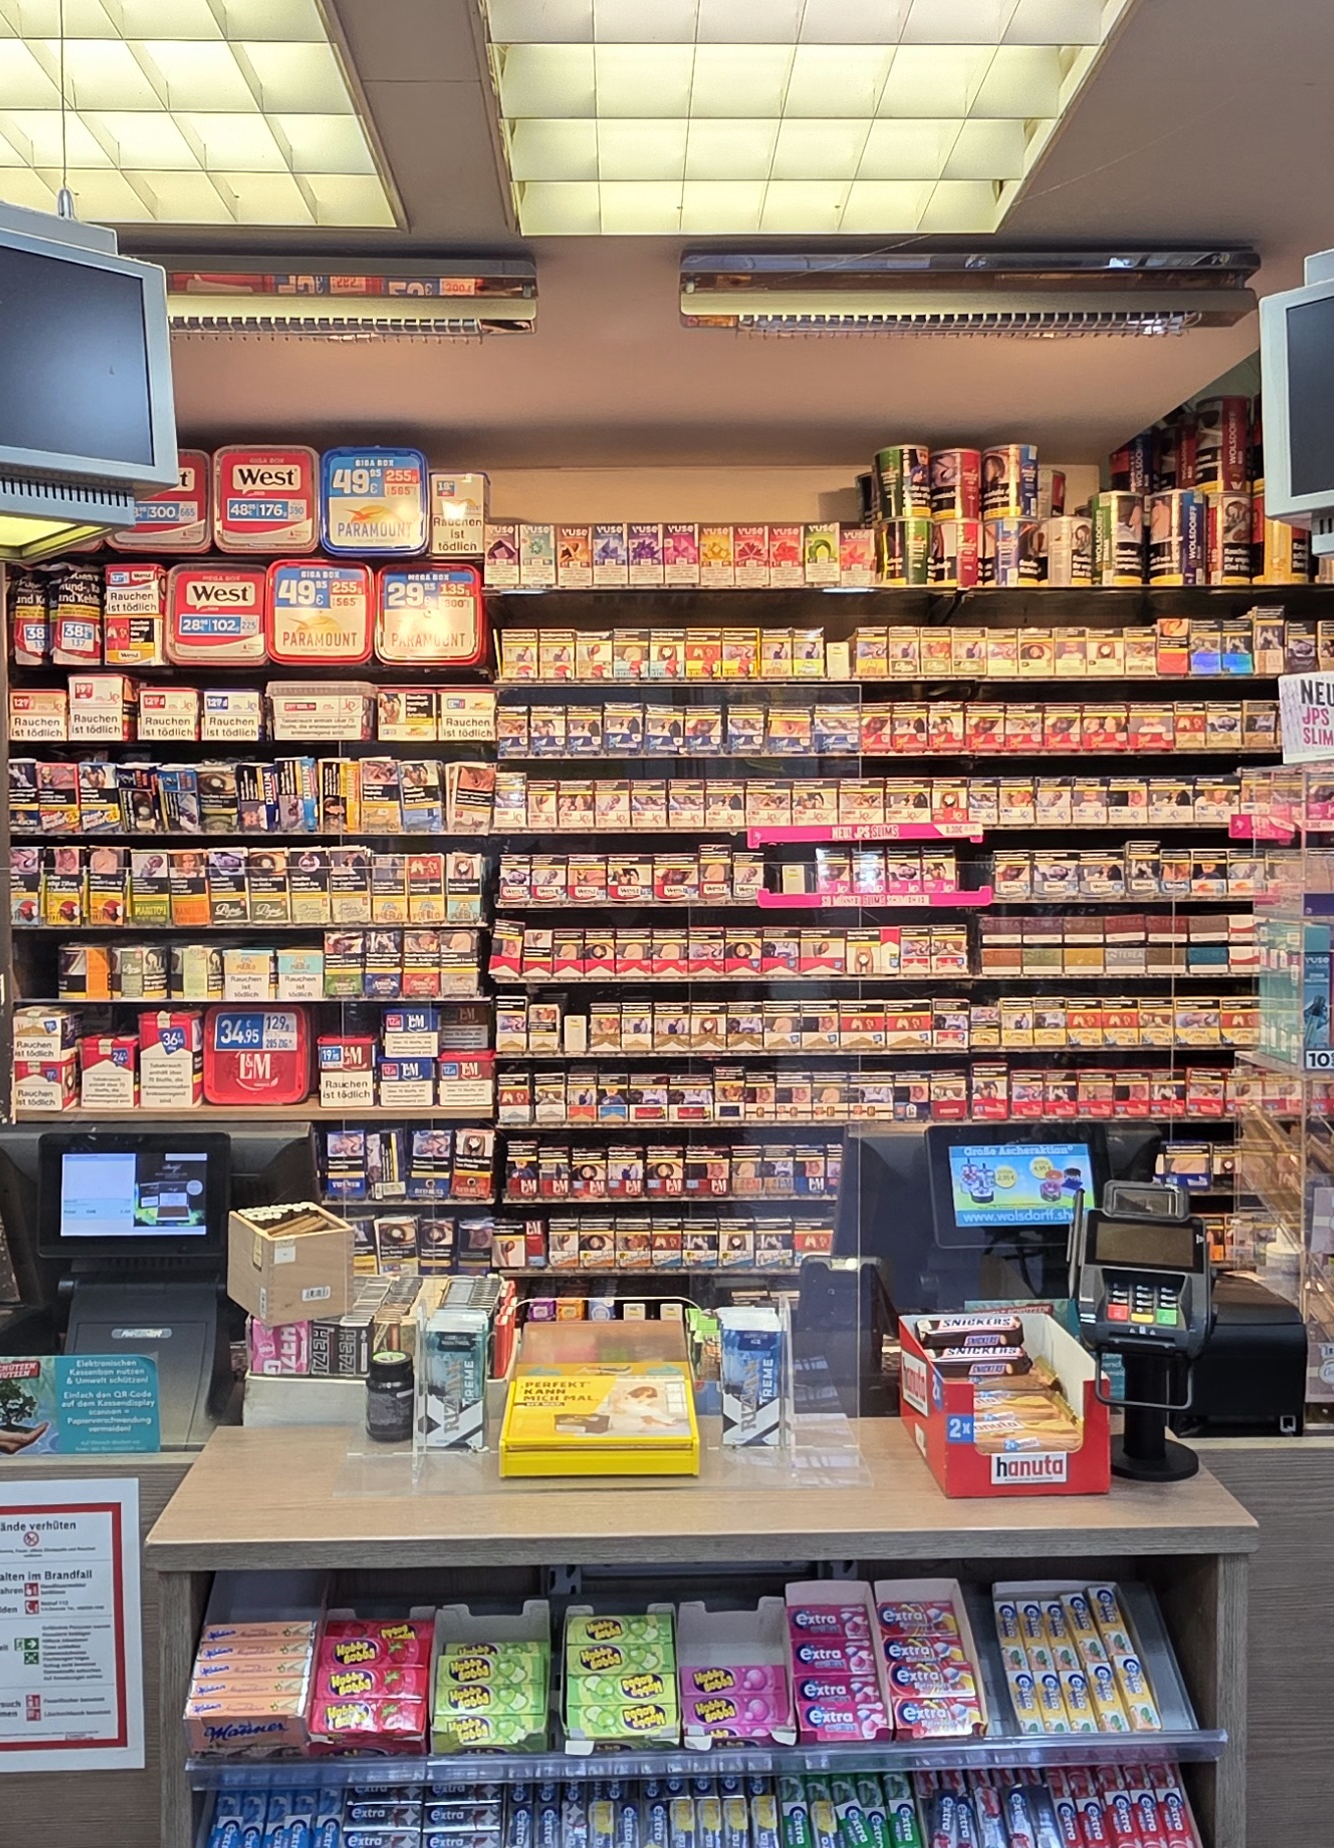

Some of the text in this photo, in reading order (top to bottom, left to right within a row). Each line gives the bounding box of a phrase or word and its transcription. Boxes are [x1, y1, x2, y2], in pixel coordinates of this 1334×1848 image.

[238, 468, 295, 486] West
[338, 522, 412, 538] PARAMOUNT
[450, 528, 464, 538] ist
[1188, 505, 1197, 560] WOLSDORFF
[438, 540, 477, 551] tödlich
[110, 591, 154, 602] Rauchen
[192, 584, 249, 602] West
[107, 601, 157, 612] ist tödlich
[283, 631, 357, 647] PARAMOUNT
[14, 718, 60, 726] Rauchen
[74, 714, 118, 724] Rauchen
[145, 717, 191, 726] Rauchen
[209, 717, 255, 726] Rauchen
[446, 718, 491, 727] Rauchen
[1302, 707, 1329, 726] JPS
[11, 727, 63, 737] ist tödlich
[71, 724, 121, 734] ist tödlich
[142, 727, 194, 736] ist tödlich
[207, 727, 257, 736] ist tödlich
[443, 728, 493, 738] ist tödlich
[264, 772, 274, 805] DRUM
[302, 765, 312, 799] DRUM
[16, 1040, 52, 1049] Rauchen
[239, 1052, 271, 1079] L&M
[325, 1080, 368, 1090] Rauchen
[323, 1090, 371, 1099] ist tödlich
[942, 1317, 1011, 1327] SNICKERS
[967, 1336, 998, 1345] SNICKERS
[947, 1347, 1017, 1356] SNICKERS
[77, 1359, 137, 1368] Elektronischen
[972, 1363, 1005, 1373] SNICKERS
[61, 1399, 155, 1409] auf dem Kassendisplay
[949, 1418, 971, 1438] 2x
[996, 1455, 1063, 1477] hanuta
[29, 1521, 77, 1531] verhüten
[28, 1571, 41, 1581] im
[45, 1570, 92, 1580] Brandfall
[796, 1612, 837, 1625] extra
[883, 1609, 923, 1622] extra
[335, 1642, 369, 1656] Hubba
[800, 1646, 841, 1659] extra
[889, 1644, 930, 1657] extra
[346, 1650, 376, 1664] Bubba
[449, 1658, 481, 1672] Hubba
[331, 1673, 365, 1686] Hubba
[459, 1665, 491, 1681] Bubba
[693, 1668, 724, 1683] Hubba
[897, 1668, 939, 1682] extra
[1124, 1658, 1142, 1694] extra
[339, 1681, 372, 1695] Bubba
[804, 1683, 846, 1696] extra
[1095, 1665, 1114, 1702] extra
[1015, 1674, 1033, 1710] extra
[809, 1709, 853, 1723] extra
[903, 1706, 947, 1720] extra
[205, 1721, 290, 1741] Manner
[1113, 1795, 1132, 1833] extra
[1164, 1792, 1184, 1831] extra
